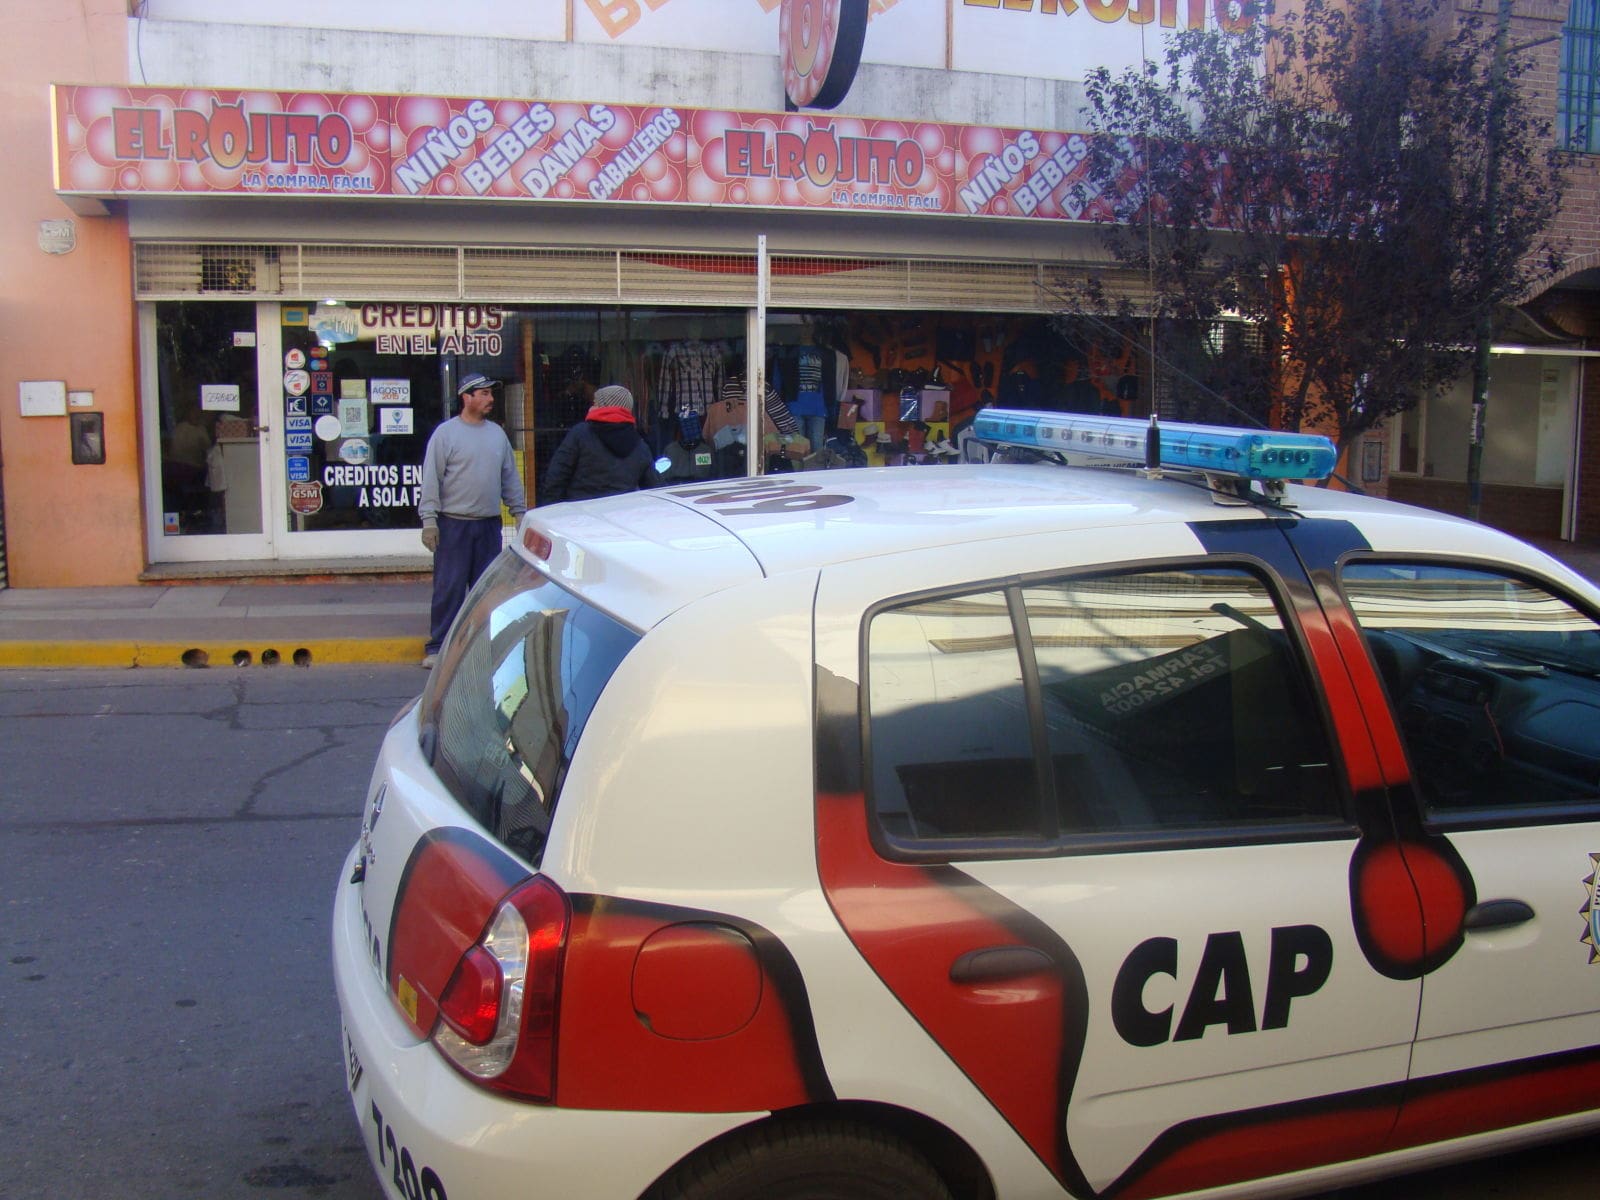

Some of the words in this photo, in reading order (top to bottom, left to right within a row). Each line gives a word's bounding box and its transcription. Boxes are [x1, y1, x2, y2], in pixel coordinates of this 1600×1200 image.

[112, 107, 170, 160] EL
[173, 98, 354, 170] ROJITO
[396, 99, 495, 196] NIÑOS
[462, 102, 556, 195] BEBES
[521, 103, 616, 199] DAMAS
[587, 107, 681, 200] CABALLEROS
[724, 129, 774, 178] EL
[775, 122, 925, 188] ROJITO
[242, 173, 263, 187] LA
[266, 173, 329, 189] COMPRA
[333, 176, 374, 190] FACIL
[958, 130, 1040, 216] NIÑOS
[1011, 133, 1088, 216] BEBES
[831, 191, 850, 204] LA
[852, 192, 905, 208] COMPRA
[907, 196, 942, 210] FACIL
[361, 303, 503, 331] CREDITOS
[376, 334, 407, 355] EN
[410, 334, 438, 355] EL
[440, 335, 502, 357] ACTO
[373, 386, 409, 395] AGOSTO
[289, 419, 311, 428] VISA
[290, 434, 312, 444] VISA
[290, 472, 308, 480] VISA
[324, 465, 399, 487] CREDITOS
[402, 464, 423, 486] EN
[292, 490, 318, 499] GSM
[358, 487, 370, 508] A
[372, 486, 410, 507] SOLA
[1111, 924, 1334, 1047] CAP
